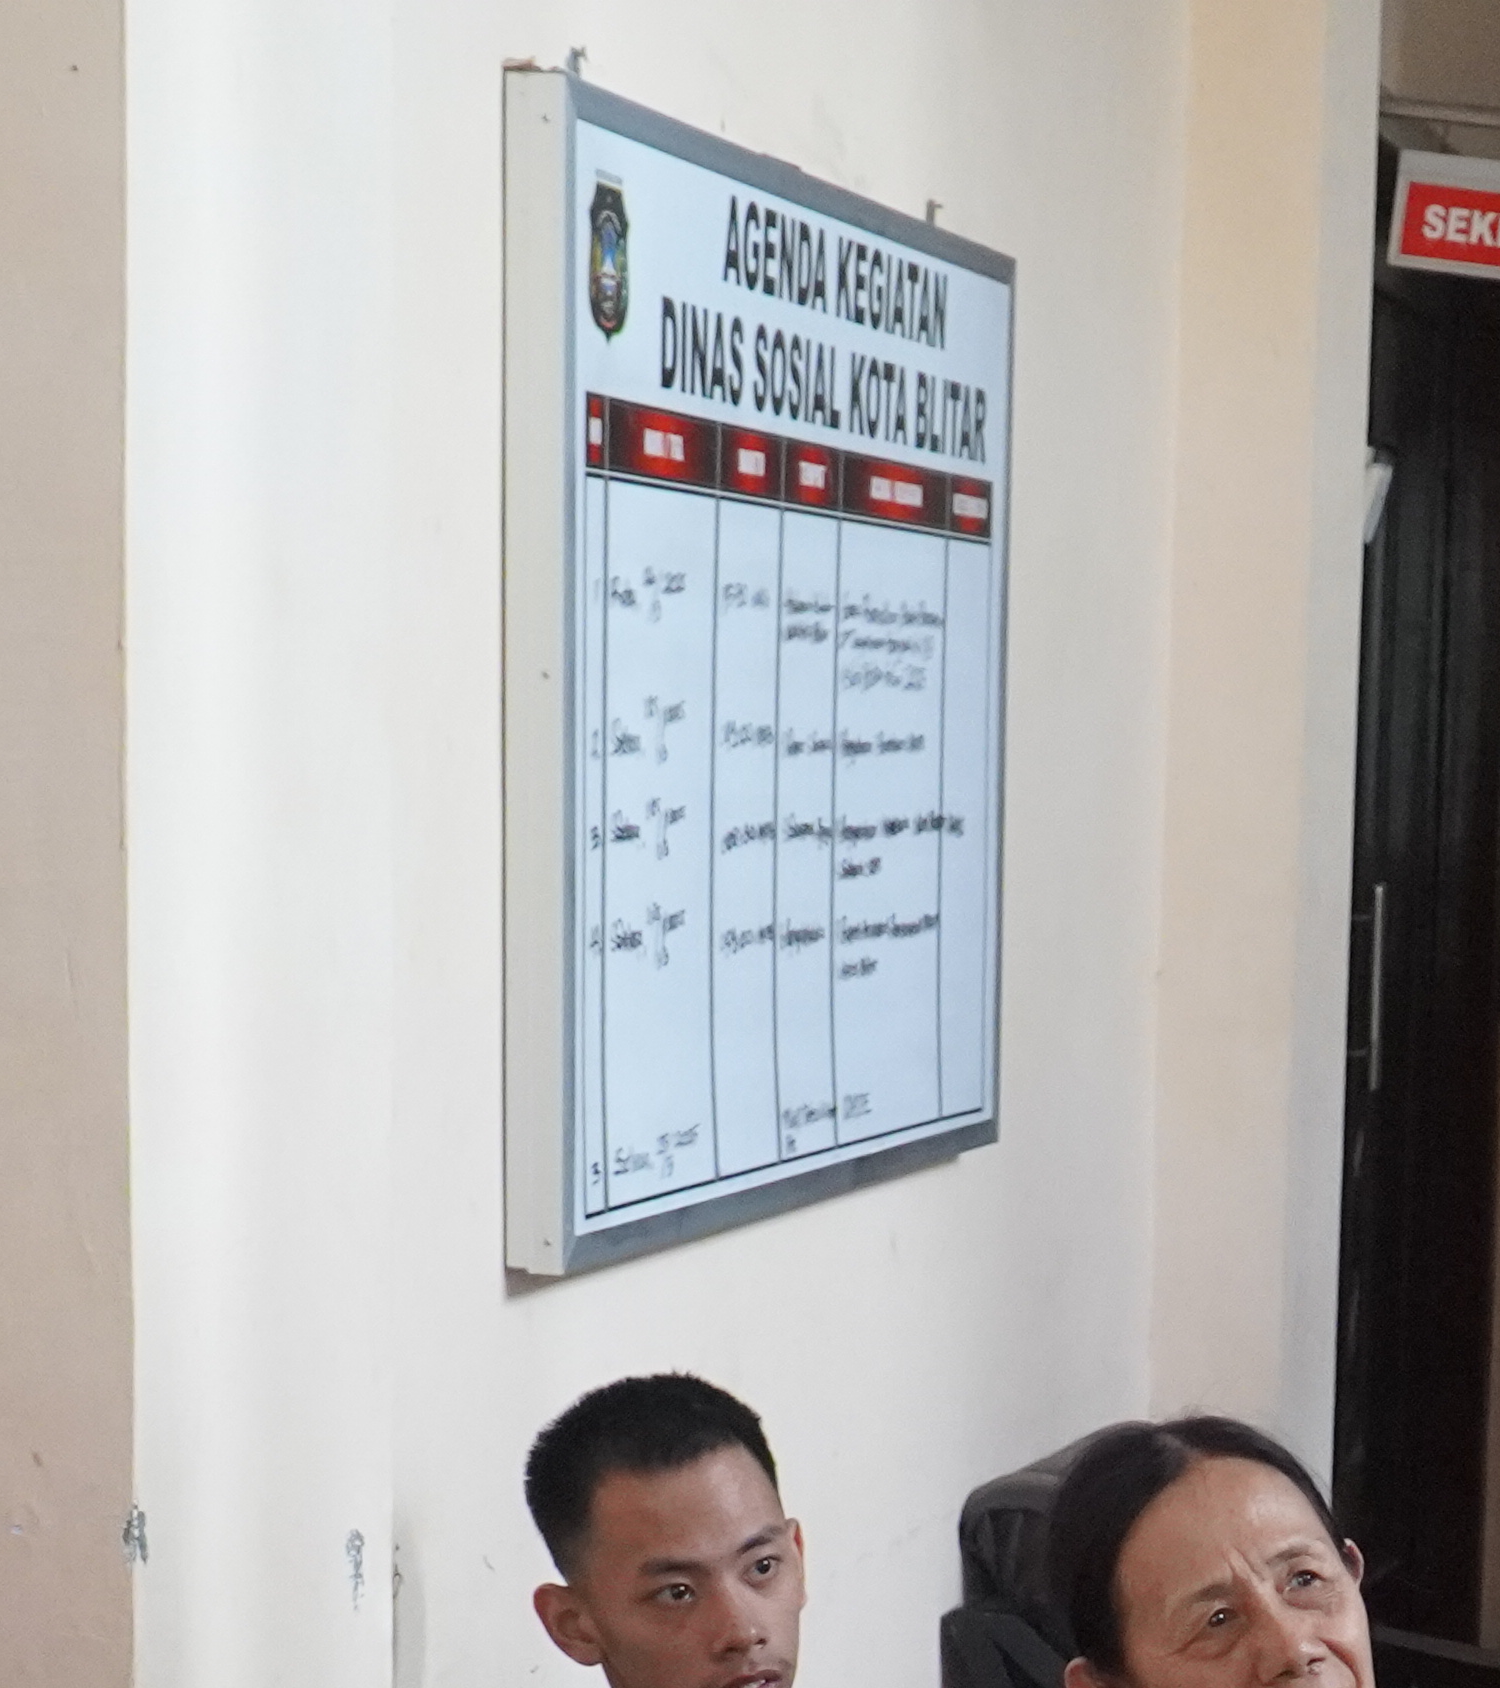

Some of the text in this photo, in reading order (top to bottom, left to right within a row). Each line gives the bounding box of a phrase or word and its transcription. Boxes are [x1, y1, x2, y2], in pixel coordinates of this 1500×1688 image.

[723, 195, 949, 351] AGENDA KEGIATAN
[660, 296, 987, 464] DINAS SOSIAL KOTA BLITAR
